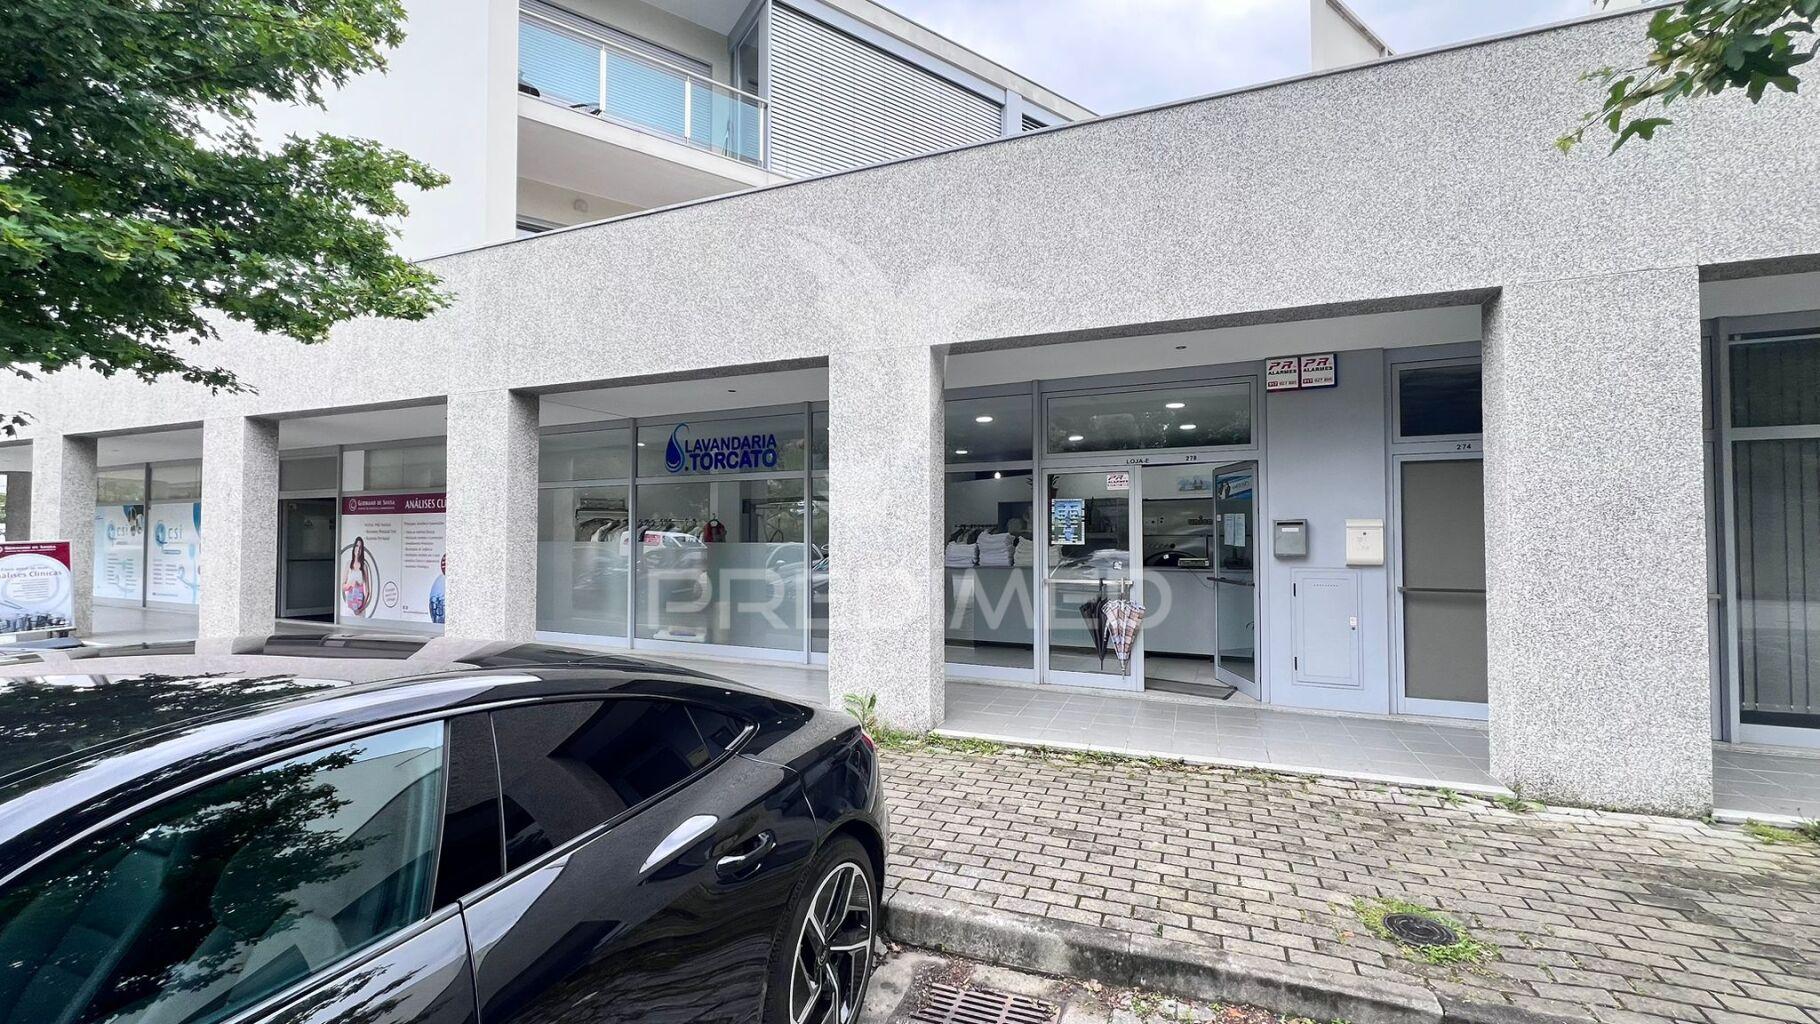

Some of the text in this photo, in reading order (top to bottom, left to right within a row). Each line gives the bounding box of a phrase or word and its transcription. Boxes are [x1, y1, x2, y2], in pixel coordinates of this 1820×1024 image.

[1268, 360, 1294, 371] PR
[1304, 357, 1329, 368] PR
[685, 434, 777, 453] LAVANDARIA
[405, 497, 435, 509] ANÁLISES
